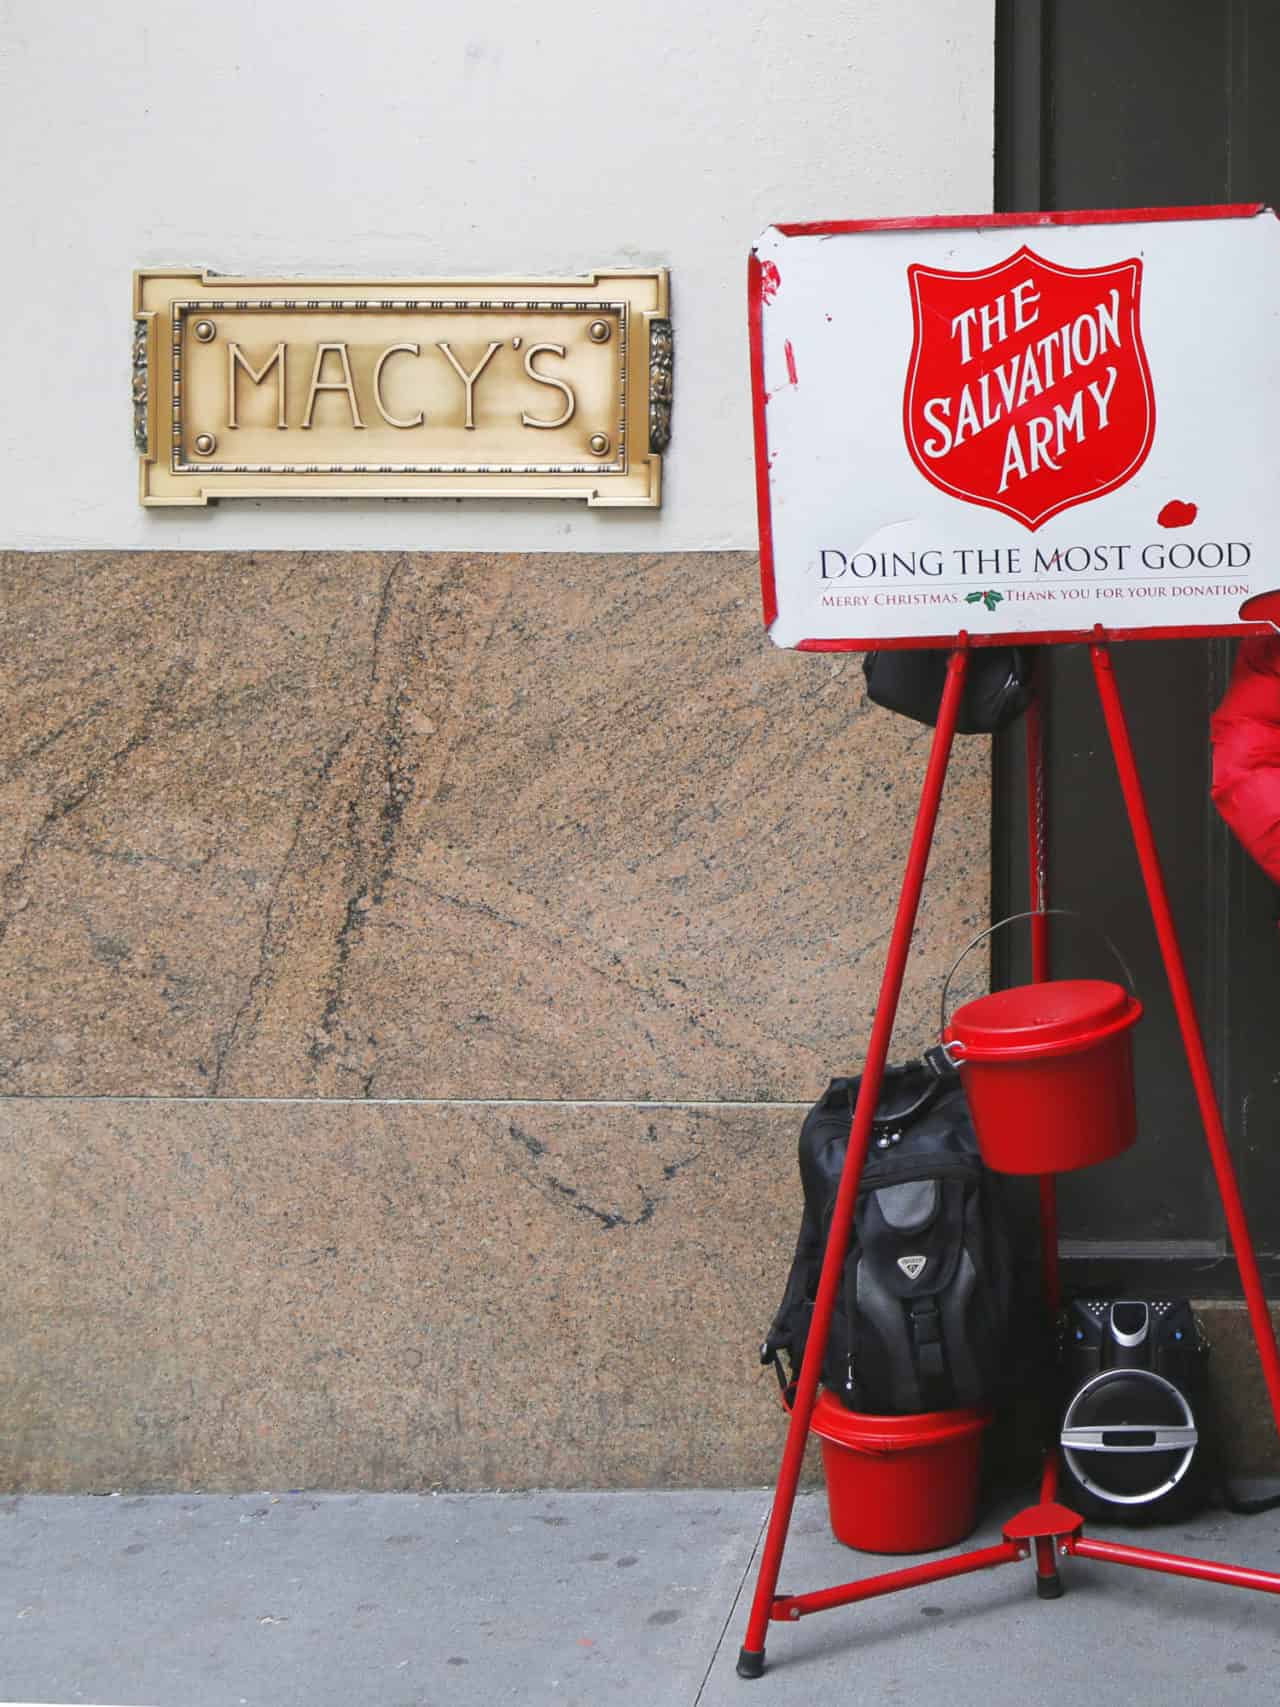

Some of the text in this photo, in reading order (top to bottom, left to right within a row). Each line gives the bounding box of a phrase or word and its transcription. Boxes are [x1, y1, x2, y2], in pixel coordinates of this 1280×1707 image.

[951, 278, 1041, 366] THE
[226, 336, 576, 430] MACY'S
[922, 288, 1122, 459] SALVATION
[997, 366, 1118, 494] ARMY
[819, 542, 1251, 579] DOING THE MOST GOOD
[821, 594, 870, 607] MERRY
[1006, 588, 1057, 602] THANK
[1060, 588, 1091, 600] YOU
[1095, 586, 1123, 599] FOR
[1127, 586, 1168, 599] YOUR
